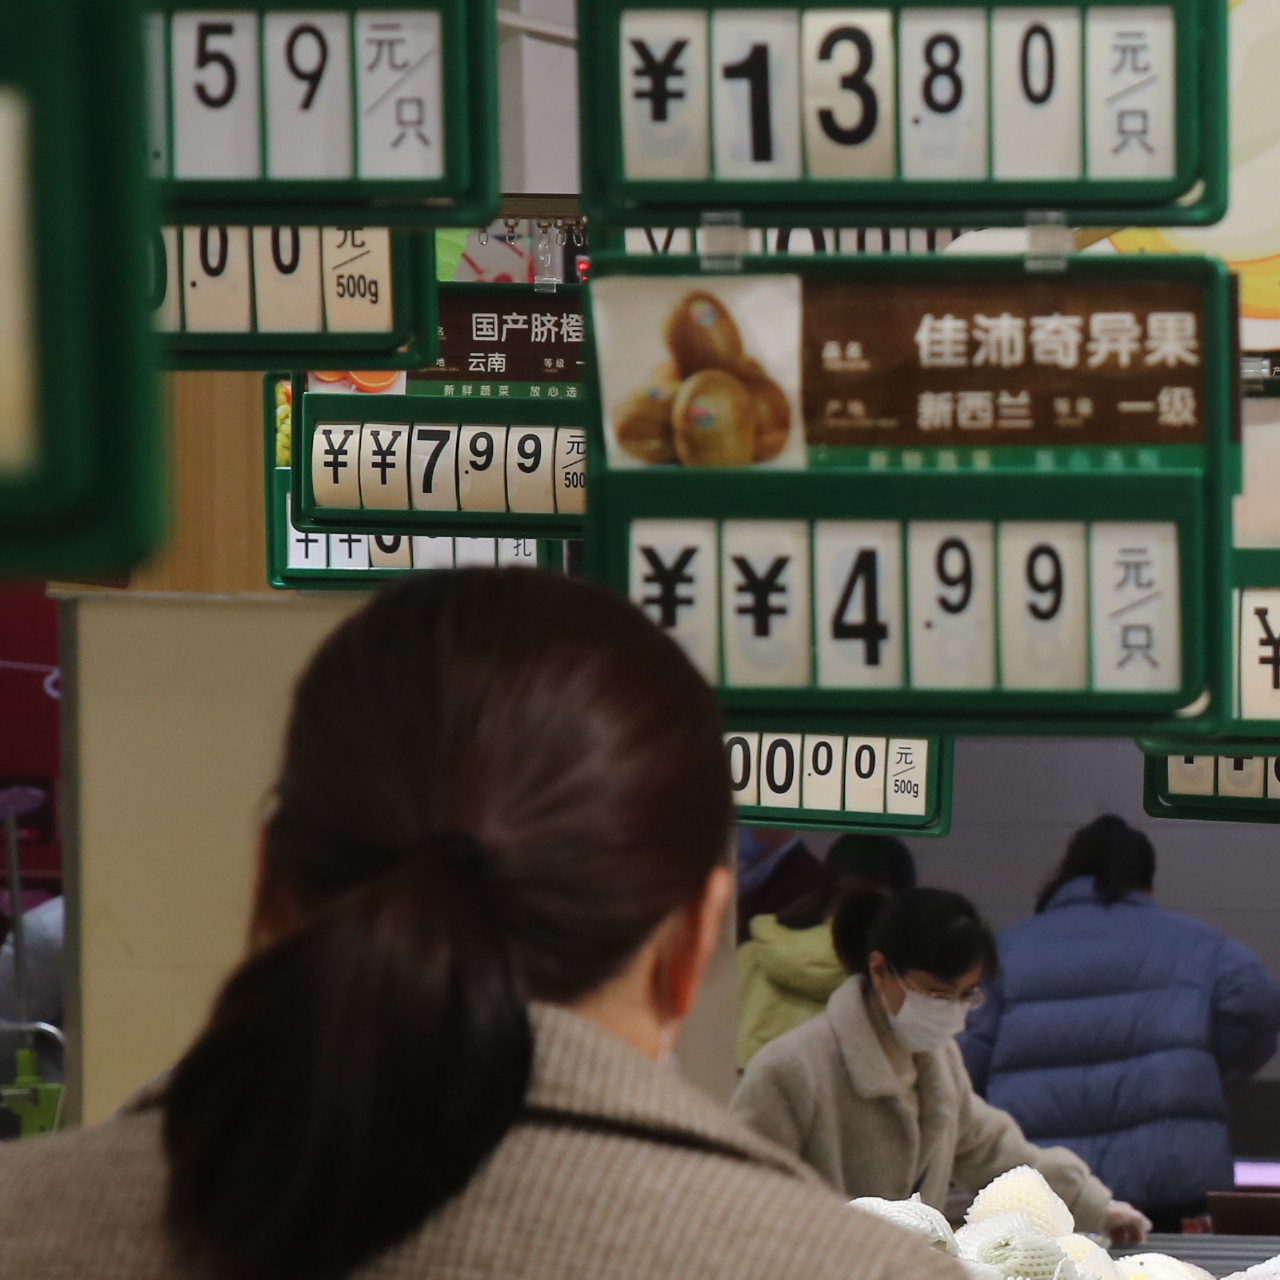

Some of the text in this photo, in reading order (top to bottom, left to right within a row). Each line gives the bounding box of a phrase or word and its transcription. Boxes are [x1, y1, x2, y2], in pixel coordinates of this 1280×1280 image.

[472, 312, 585, 343] 国产脐橙
[915, 312, 1200, 369] 佳沛奇异果
[468, 352, 507, 373] 云南
[443, 384, 510, 397] 新鲜蔬菜
[917, 391, 1034, 431] 新西兰
[1118, 387, 1198, 427] 一级
